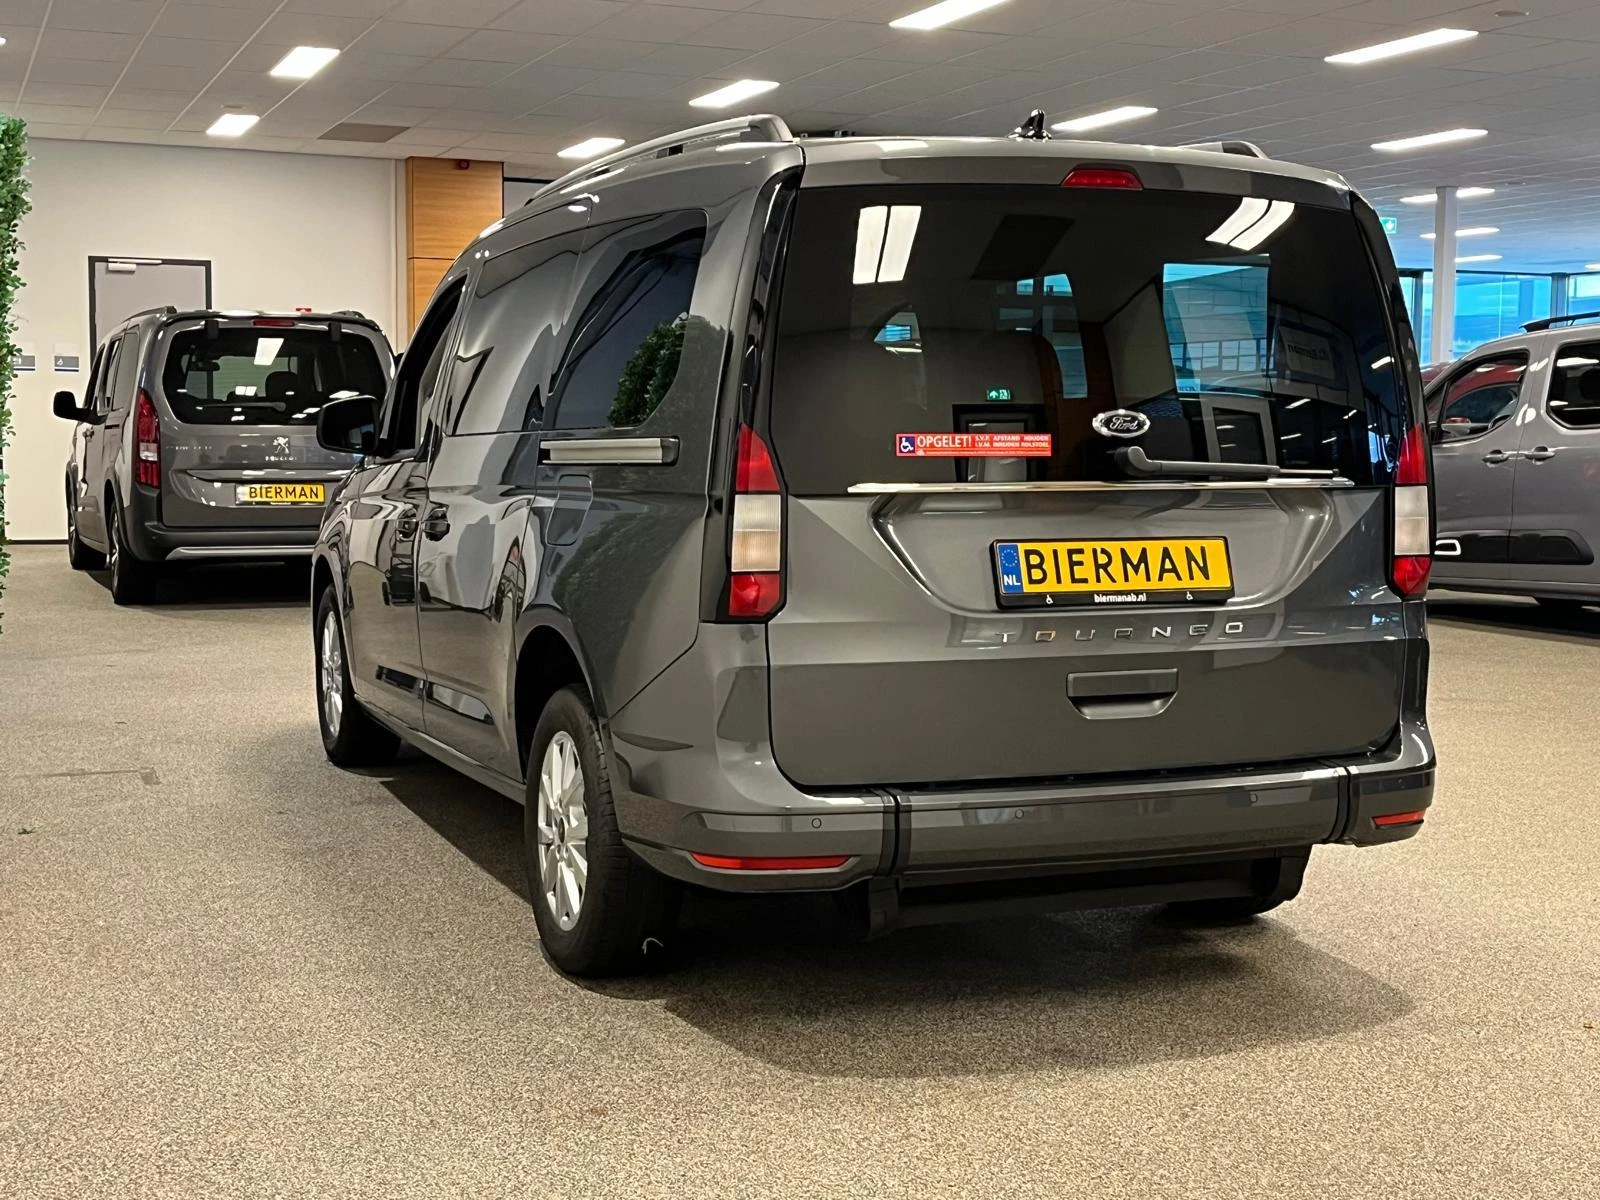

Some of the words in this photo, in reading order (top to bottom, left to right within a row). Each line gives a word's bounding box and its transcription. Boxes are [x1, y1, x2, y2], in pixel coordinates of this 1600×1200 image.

[1109, 416, 1138, 430] Ford
[917, 435, 972, 448] OPGELET!
[249, 485, 319, 499] BIERMAN
[1023, 545, 1211, 585] BIERMAN
[1003, 574, 1021, 586] NL
[1094, 593, 1147, 603] biermanab.nl
[994, 622, 1244, 643] TOURNEO
